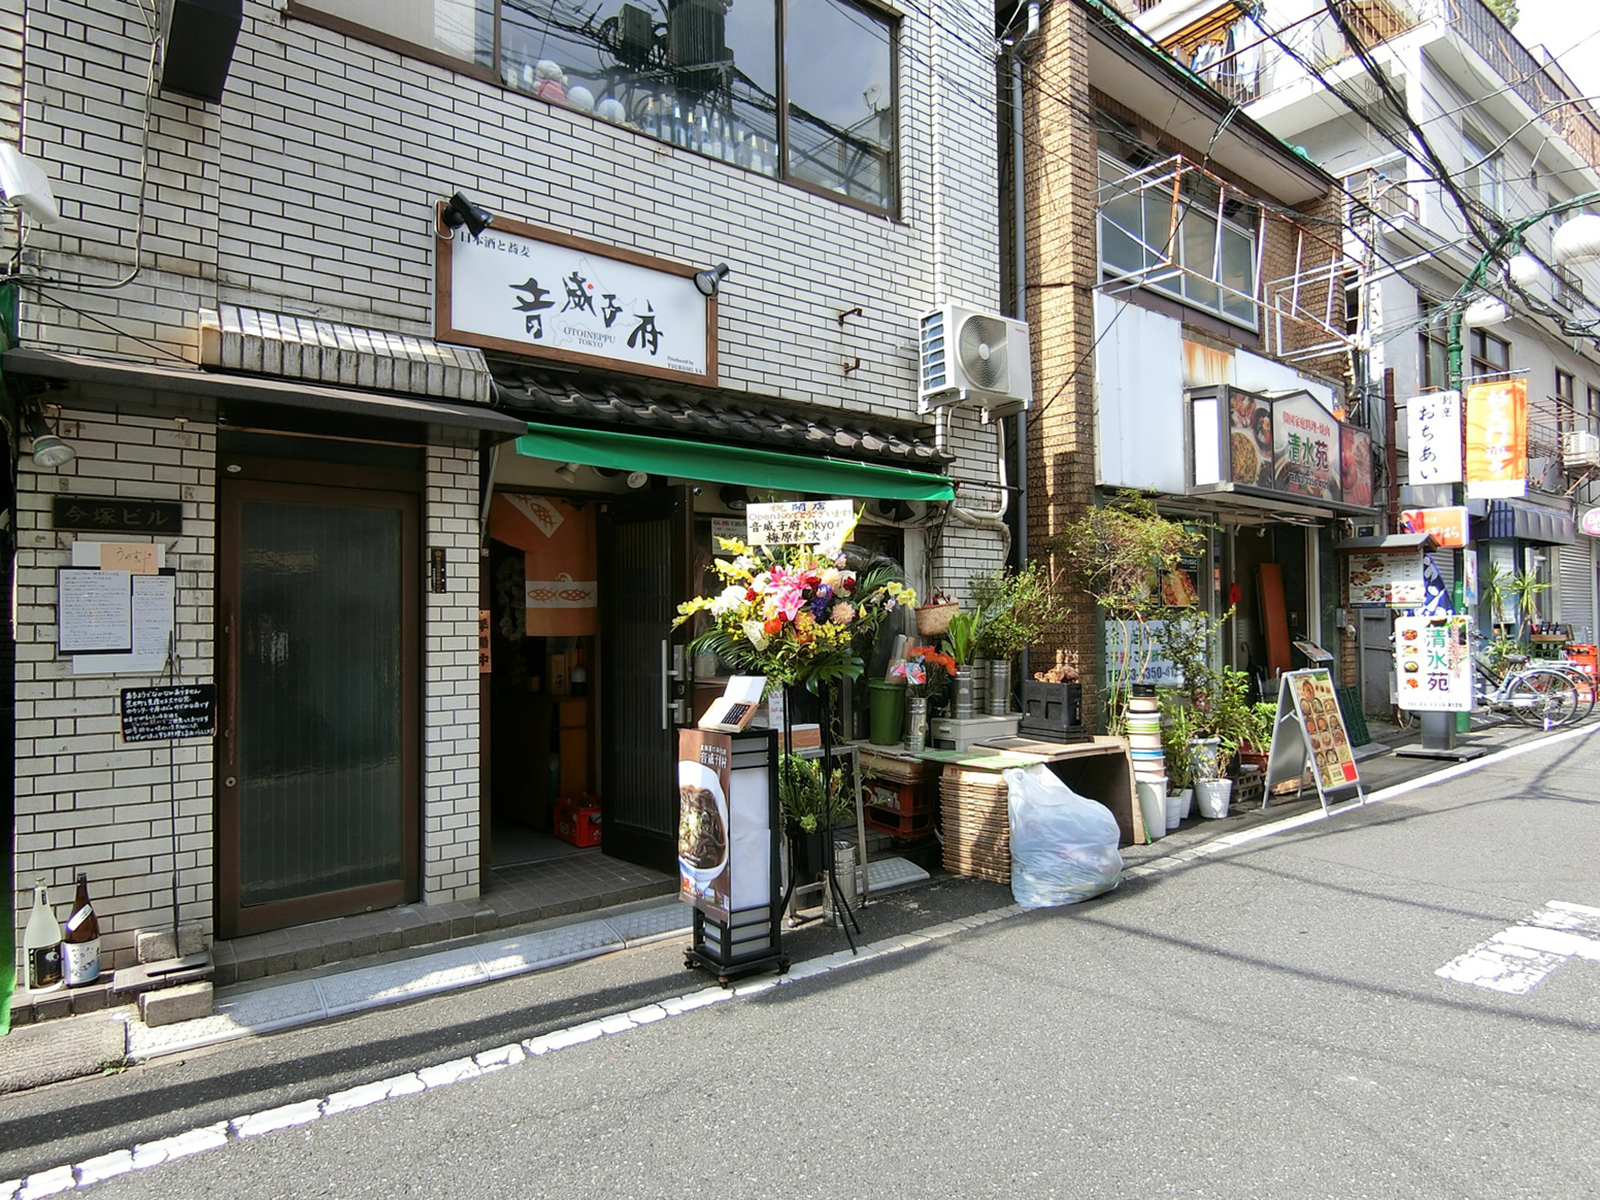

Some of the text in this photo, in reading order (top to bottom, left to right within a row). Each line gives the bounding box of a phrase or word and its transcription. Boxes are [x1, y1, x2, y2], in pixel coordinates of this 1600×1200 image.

[509, 271, 664, 356] 音威子府
[563, 326, 616, 344] OTOINEPPU
[577, 337, 604, 349] TOKYO
[1287, 431, 1330, 472] 清水苑
[1418, 403, 1439, 480] おちあい
[64, 505, 170, 526] 今塚ビル
[1426, 628, 1449, 692] 清水苑
